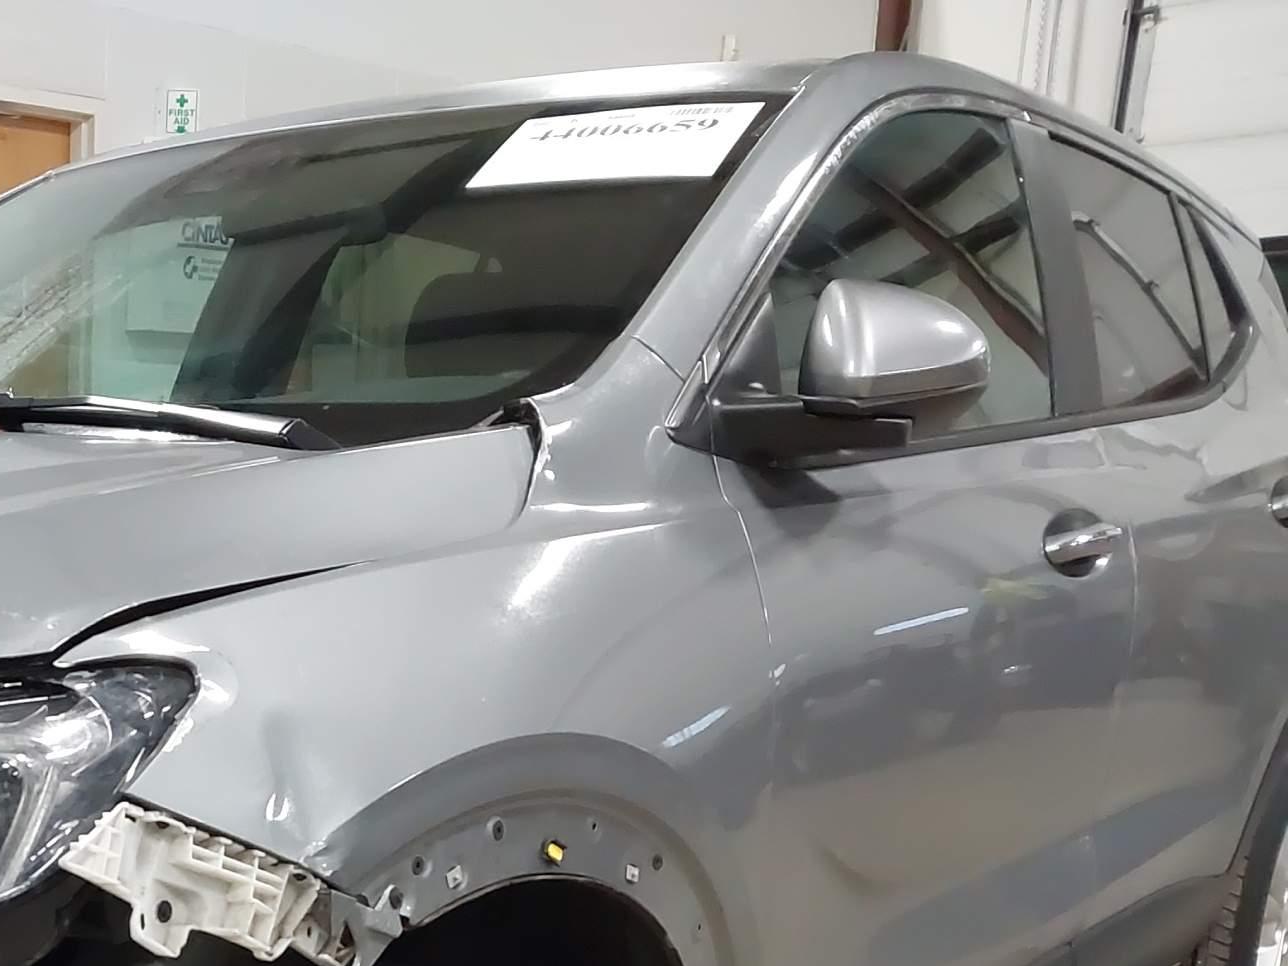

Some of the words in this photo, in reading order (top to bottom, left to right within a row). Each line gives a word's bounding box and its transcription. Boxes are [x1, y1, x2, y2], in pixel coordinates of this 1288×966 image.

[168, 109, 196, 117] FIRST
[173, 117, 190, 125] AID
[529, 118, 720, 141] 44006659
